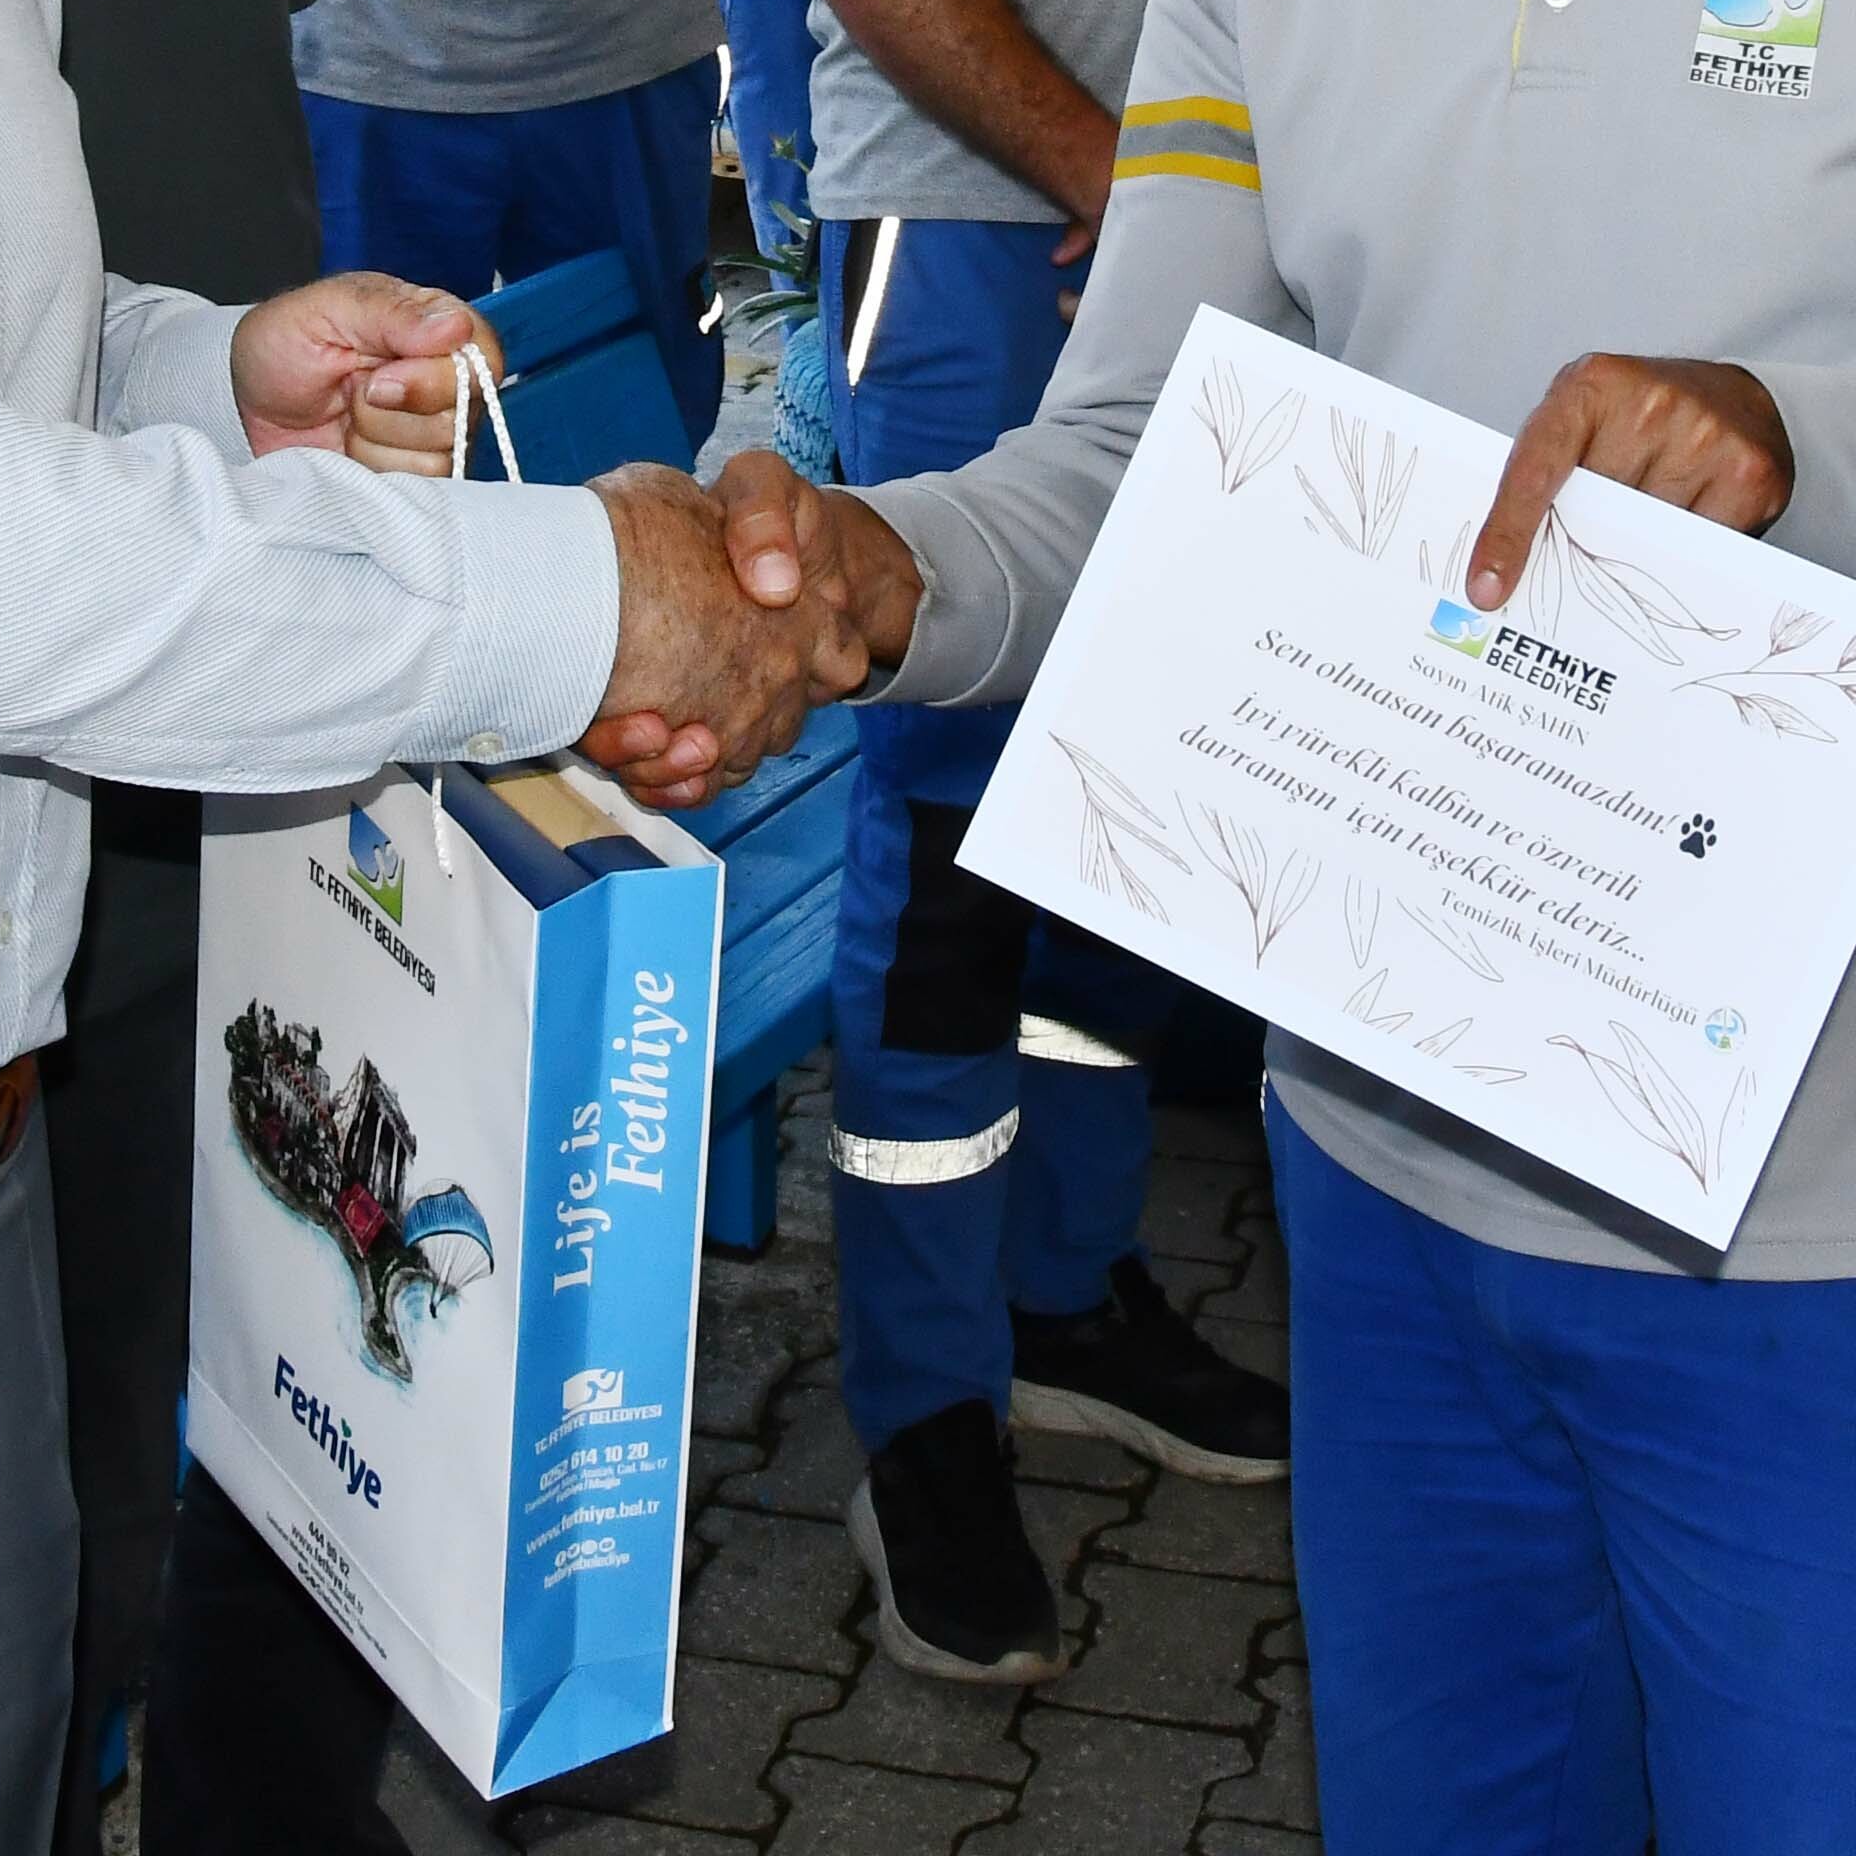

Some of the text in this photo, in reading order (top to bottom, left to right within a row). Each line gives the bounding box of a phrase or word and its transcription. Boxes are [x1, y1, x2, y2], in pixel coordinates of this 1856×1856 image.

[1738, 42, 1776, 60] T.C
[1254, 628, 1681, 835] Sen olmasan başaramazdım!
[1408, 653, 1468, 694] Sayın
[1518, 703, 1591, 748] ŞAHİN
[1178, 724, 1646, 963] davranışın için teşekkür ederiz...
[1232, 691, 1644, 903] İyi yürekli kalbin ve özverili
[1440, 887, 1699, 1027] Temizlik İşleri Müdürlüğü
[605, 969, 689, 1194] Fethiye
[551, 1100, 612, 1297] Life is
[274, 1353, 382, 1510] Fethiye
[570, 1447, 598, 1469] 614
[603, 1445, 623, 1463] 10
[626, 1441, 649, 1459] 20
